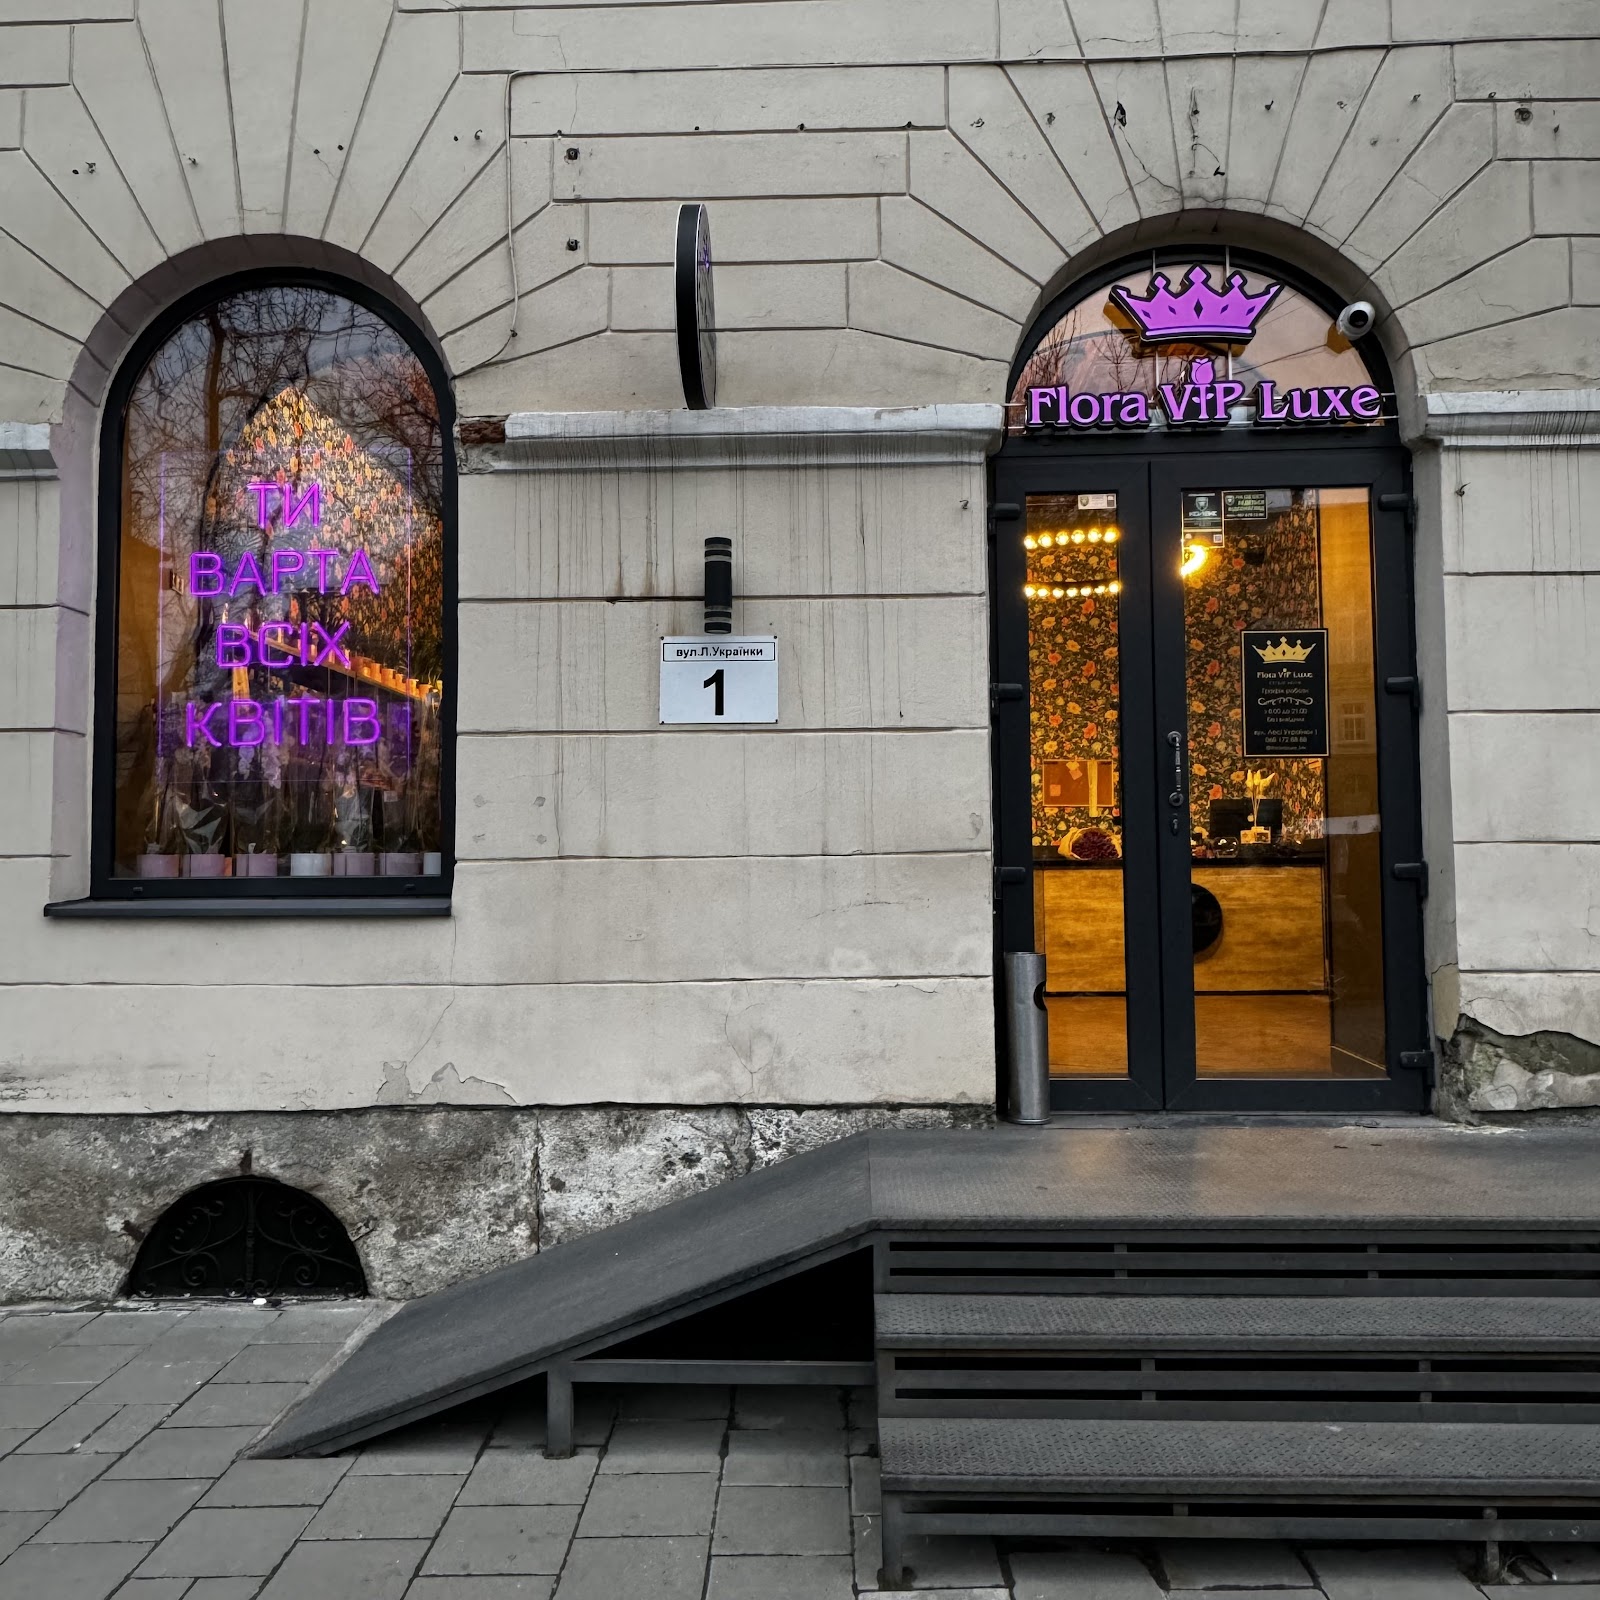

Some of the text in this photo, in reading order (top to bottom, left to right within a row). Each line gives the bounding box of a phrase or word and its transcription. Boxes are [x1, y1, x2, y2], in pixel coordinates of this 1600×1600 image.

[1027, 385, 1149, 424] Flora
[1257, 381, 1382, 422] Luxe
[247, 481, 321, 530] ТИ
[189, 549, 380, 597] ВАРТА
[216, 621, 352, 670] ВСІХ
[676, 646, 763, 659] вул.Л.Українки
[703, 668, 725, 716] 1
[1256, 671, 1277, 679] Flora
[185, 697, 382, 748] КВІТІВ
